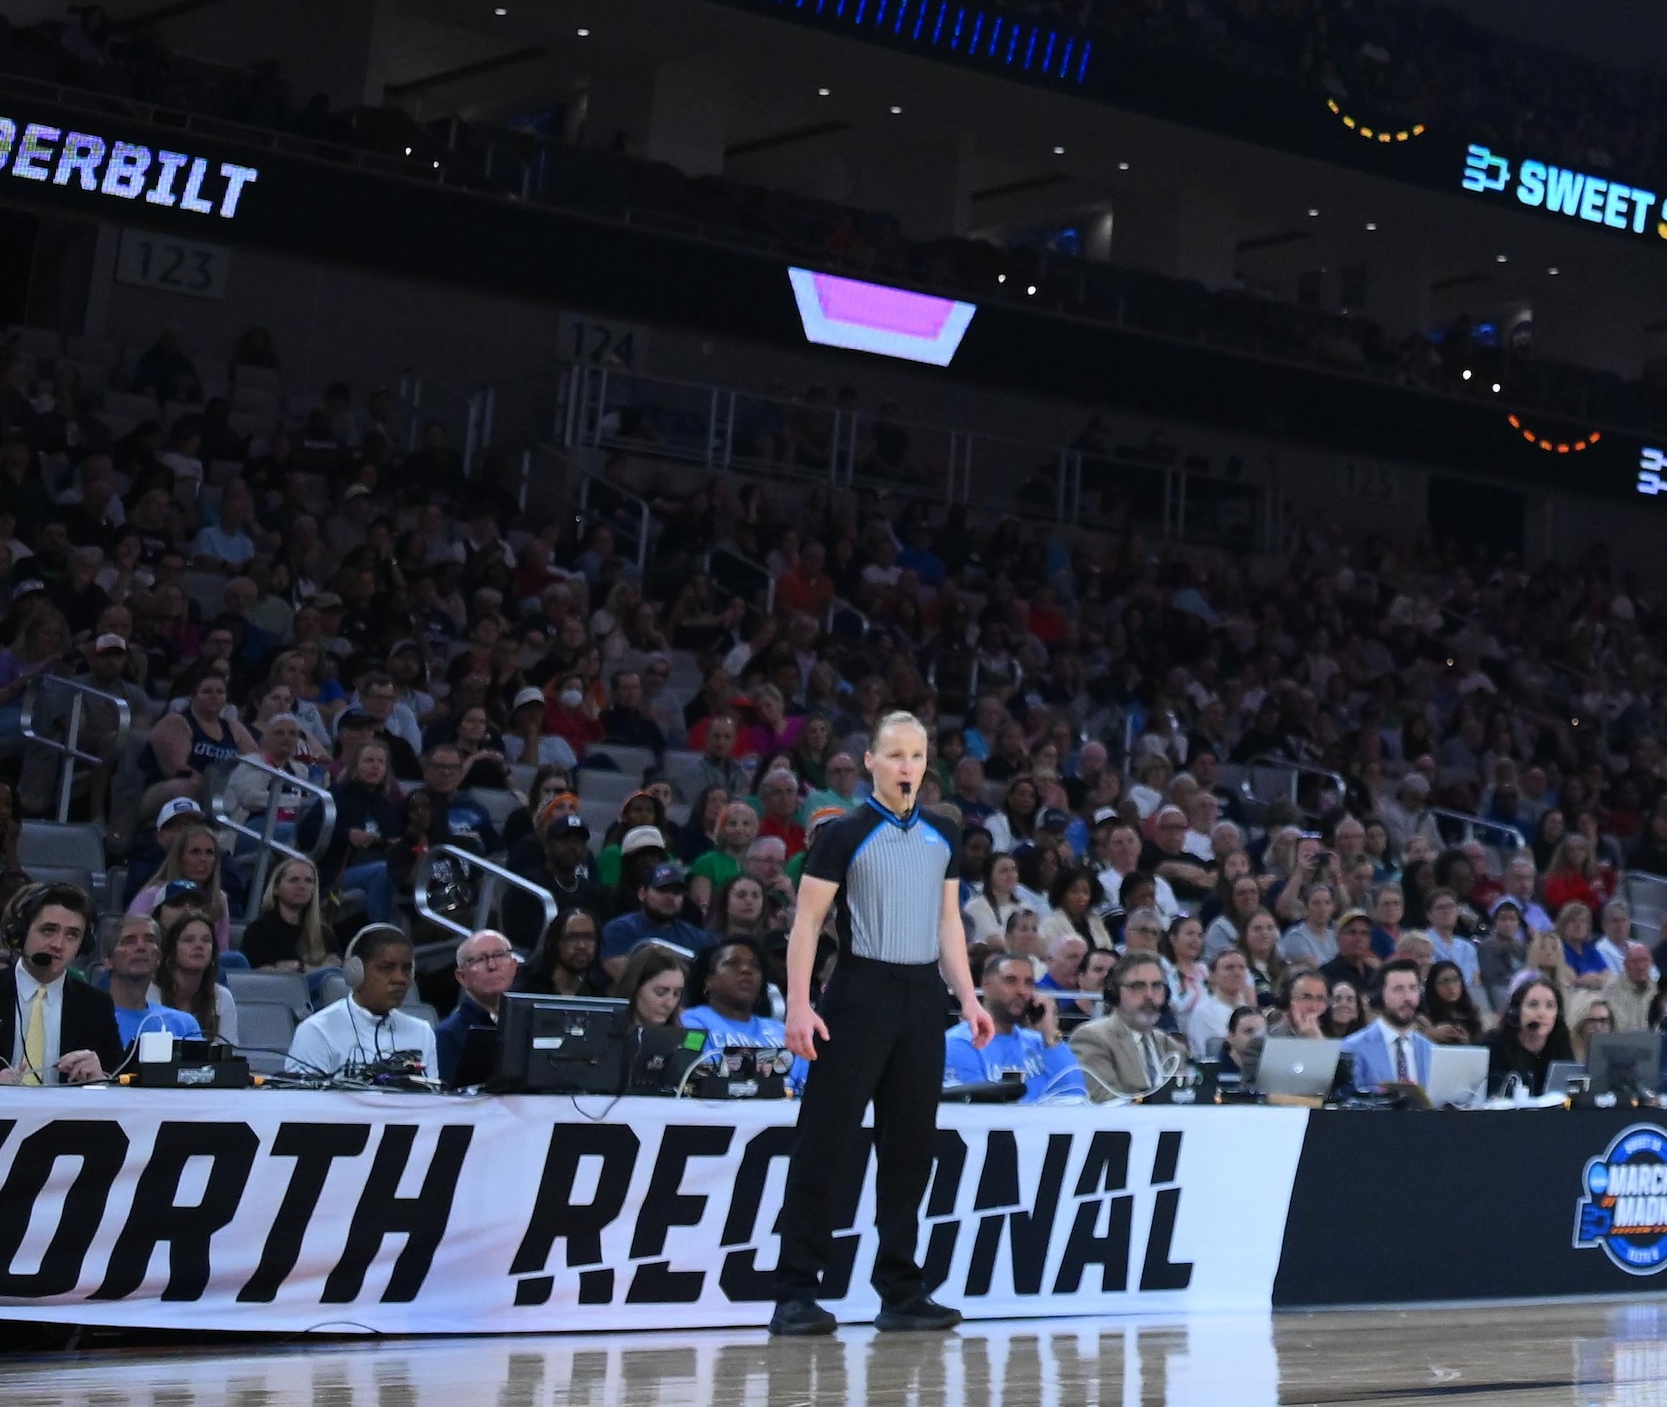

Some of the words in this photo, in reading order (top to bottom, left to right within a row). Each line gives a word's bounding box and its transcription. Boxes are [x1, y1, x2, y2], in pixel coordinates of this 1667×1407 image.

[1516, 158, 1656, 234] SWEET
[137, 240, 214, 291] 123
[570, 320, 636, 365] 124
[0, 1119, 475, 1304] ORTH
